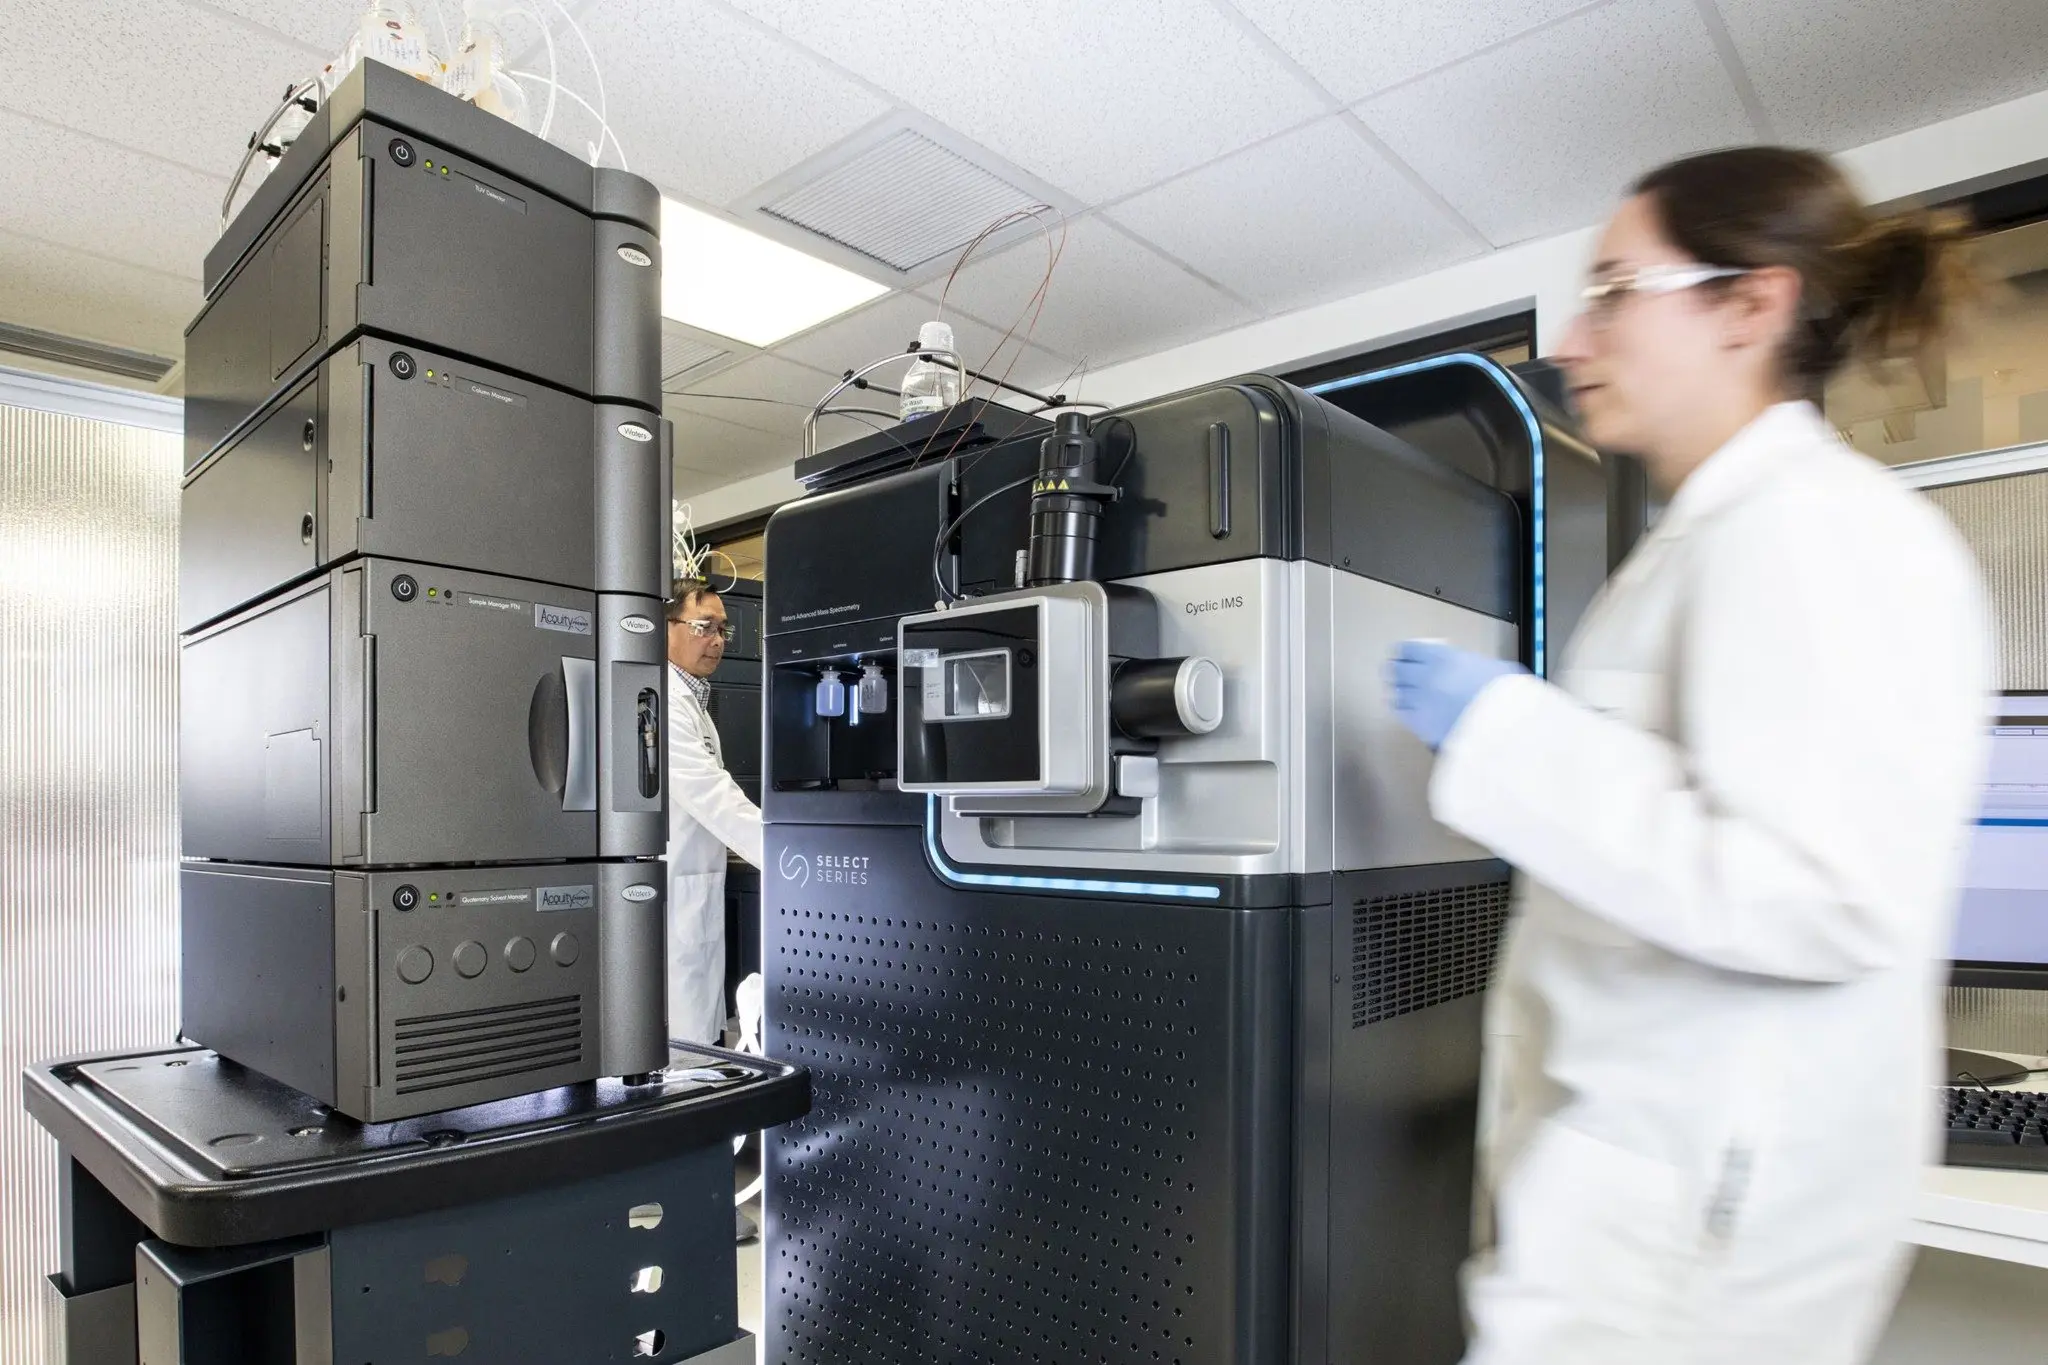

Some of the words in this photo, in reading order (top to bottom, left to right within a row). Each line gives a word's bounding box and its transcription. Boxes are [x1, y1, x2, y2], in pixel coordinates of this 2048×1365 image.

[623, 250, 647, 264] Waters
[471, 385, 491, 396] Column
[491, 391, 513, 403] Manager
[623, 426, 648, 439] Waters
[468, 597, 487, 606] Sample
[487, 600, 510, 610] Manager
[1185, 600, 1218, 616] Cyclic
[1221, 596, 1243, 609] IMS
[796, 610, 817, 619] Advanced
[817, 608, 829, 616] Mass
[829, 604, 860, 614] Spectrometry
[625, 619, 650, 630] Waters
[816, 855, 869, 869] SELECT
[816, 869, 868, 885] SERIES
[627, 889, 652, 898] Waters
